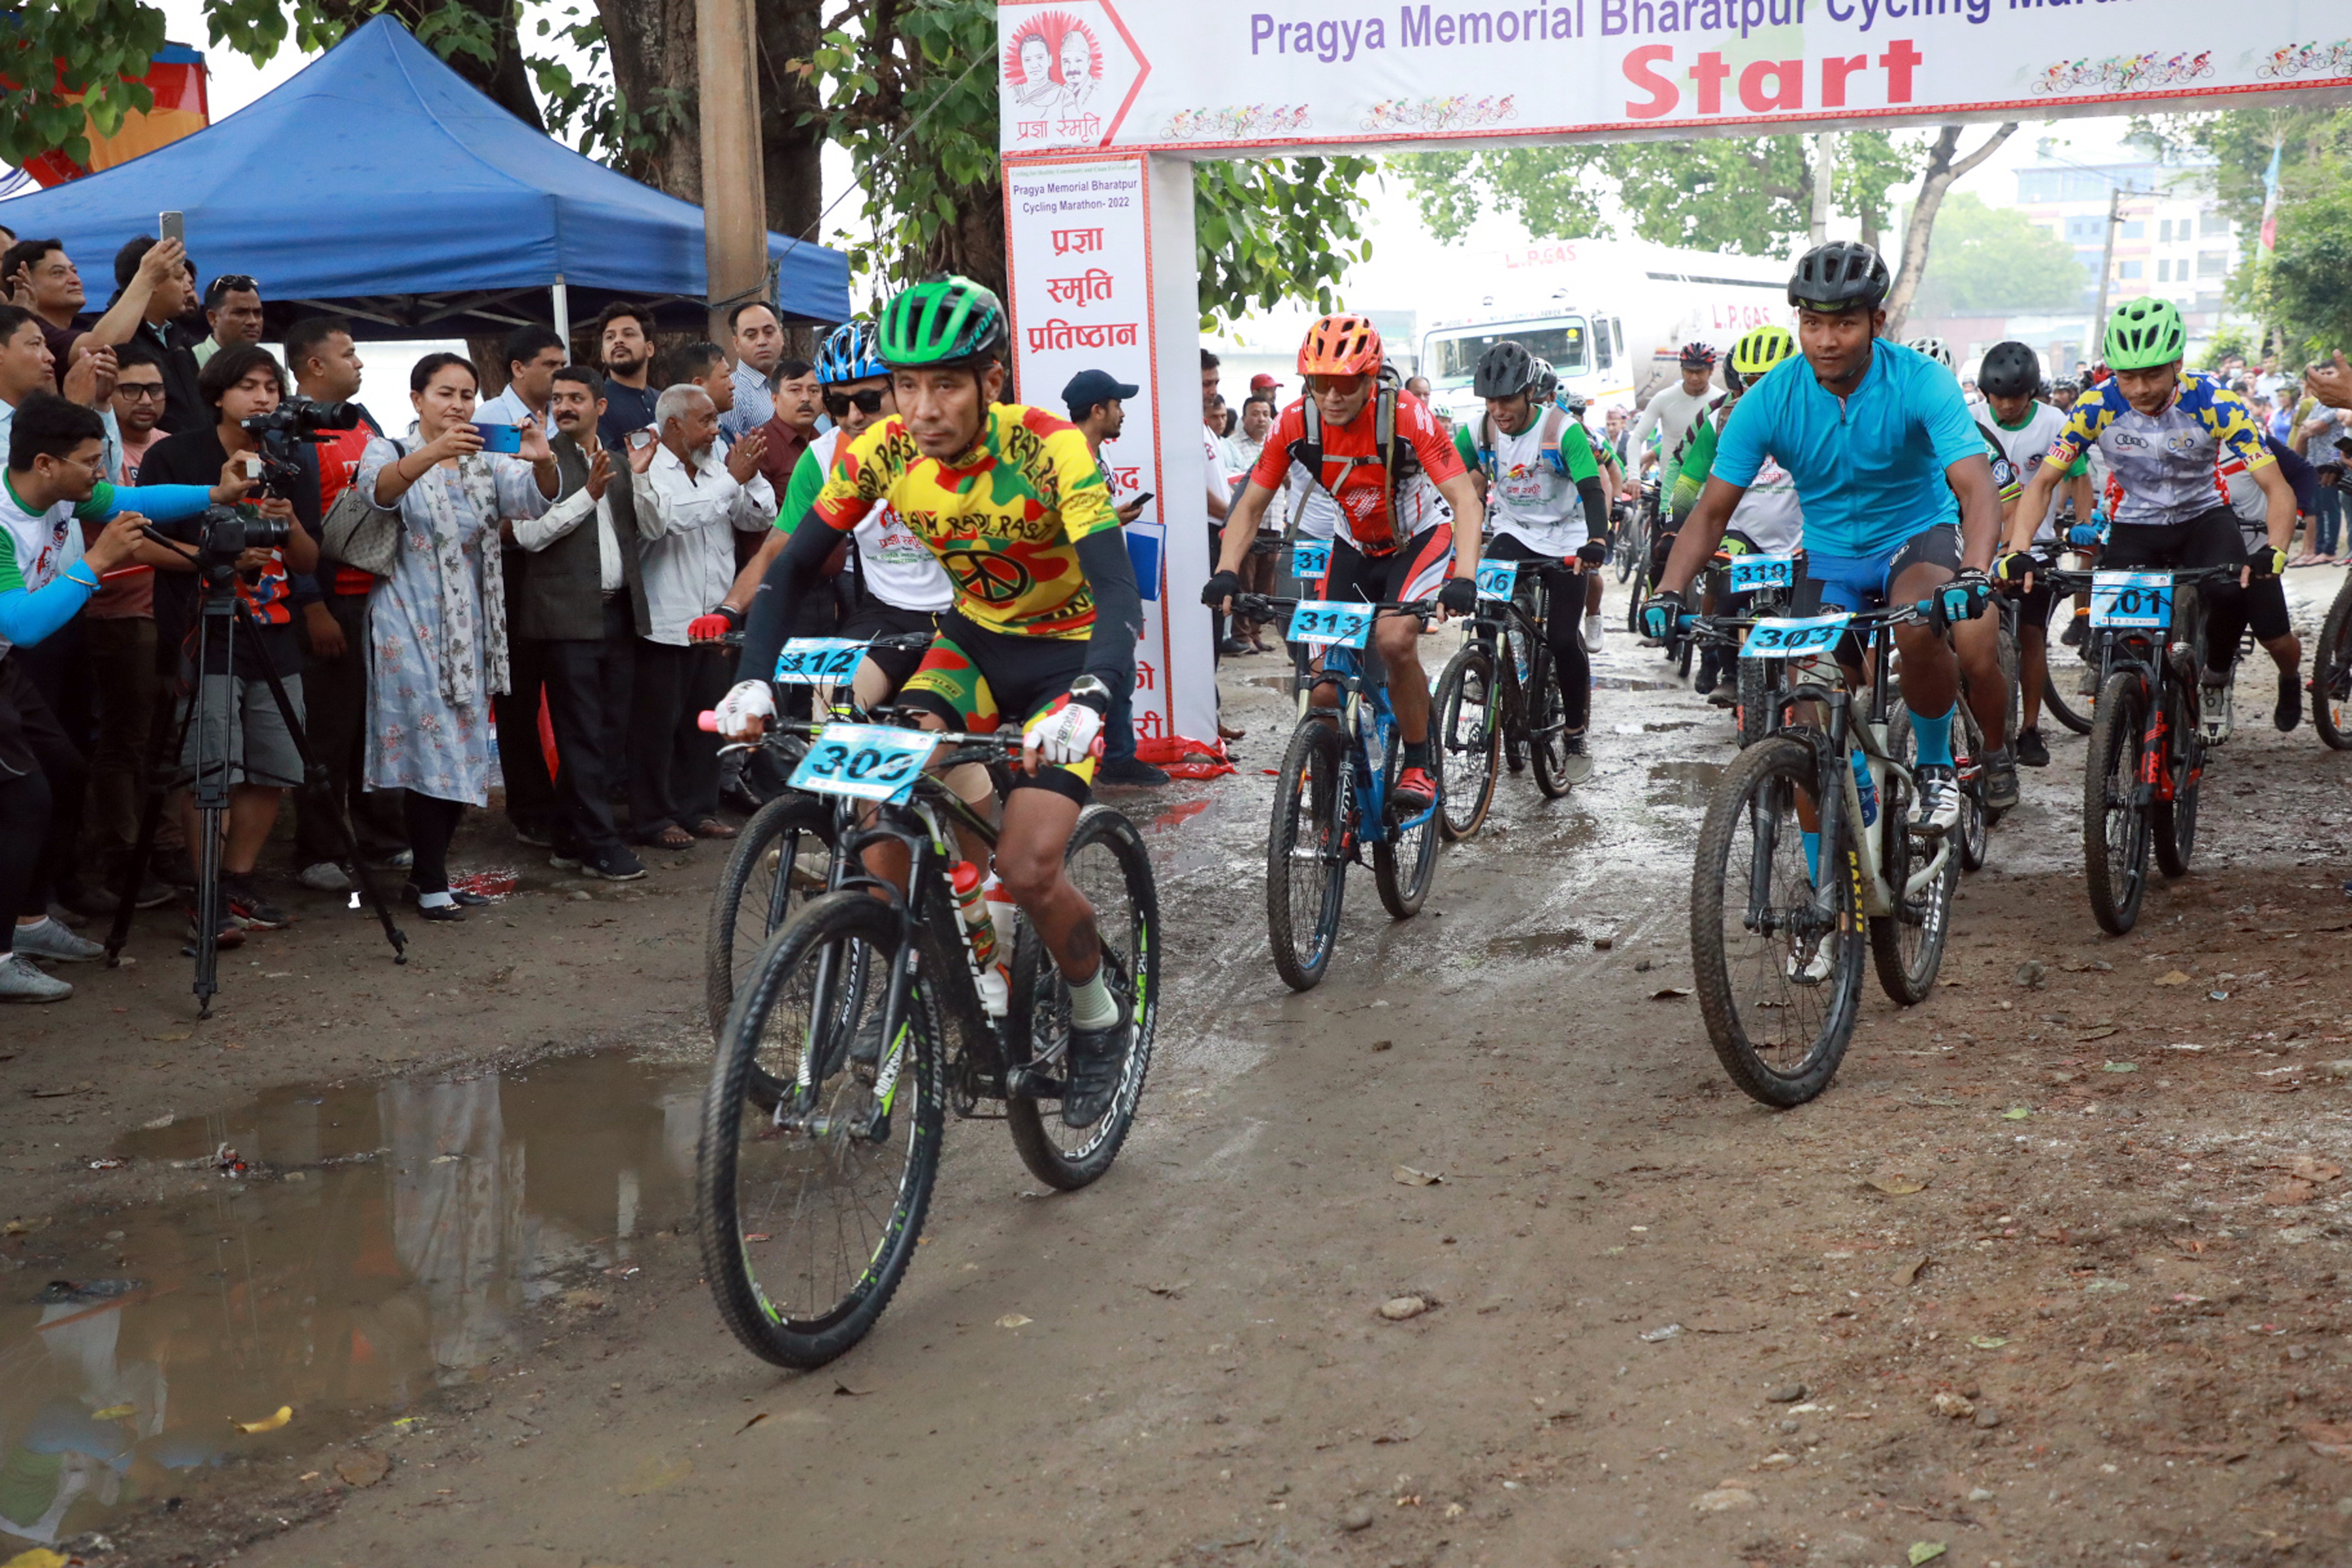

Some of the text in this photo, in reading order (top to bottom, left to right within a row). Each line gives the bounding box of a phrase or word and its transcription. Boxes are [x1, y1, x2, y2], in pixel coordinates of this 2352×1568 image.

[1251, 13, 1385, 63] Pragya
[1401, 0, 1582, 48] Memorial
[1601, 0, 1811, 38] Bharatpur
[1622, 39, 1922, 119] Start
[1017, 112, 1101, 143] प्रज्ञा स्मृति
[1013, 179, 1137, 197] Pragya Memorial Bharatpur
[1022, 201, 1057, 214] Cycling
[1108, 197, 1130, 208] 2022
[1051, 228, 1104, 256] प्रज्ञा
[1046, 268, 1114, 307] स्मृति
[1027, 318, 1138, 353] प्रतिष्ठान
[1298, 552, 1326, 570] 31
[1298, 612, 1363, 636] 313
[1754, 625, 1837, 648] 303
[781, 651, 856, 673] 312
[812, 745, 914, 781] 309
[1848, 851, 1864, 932] MAXXIS
